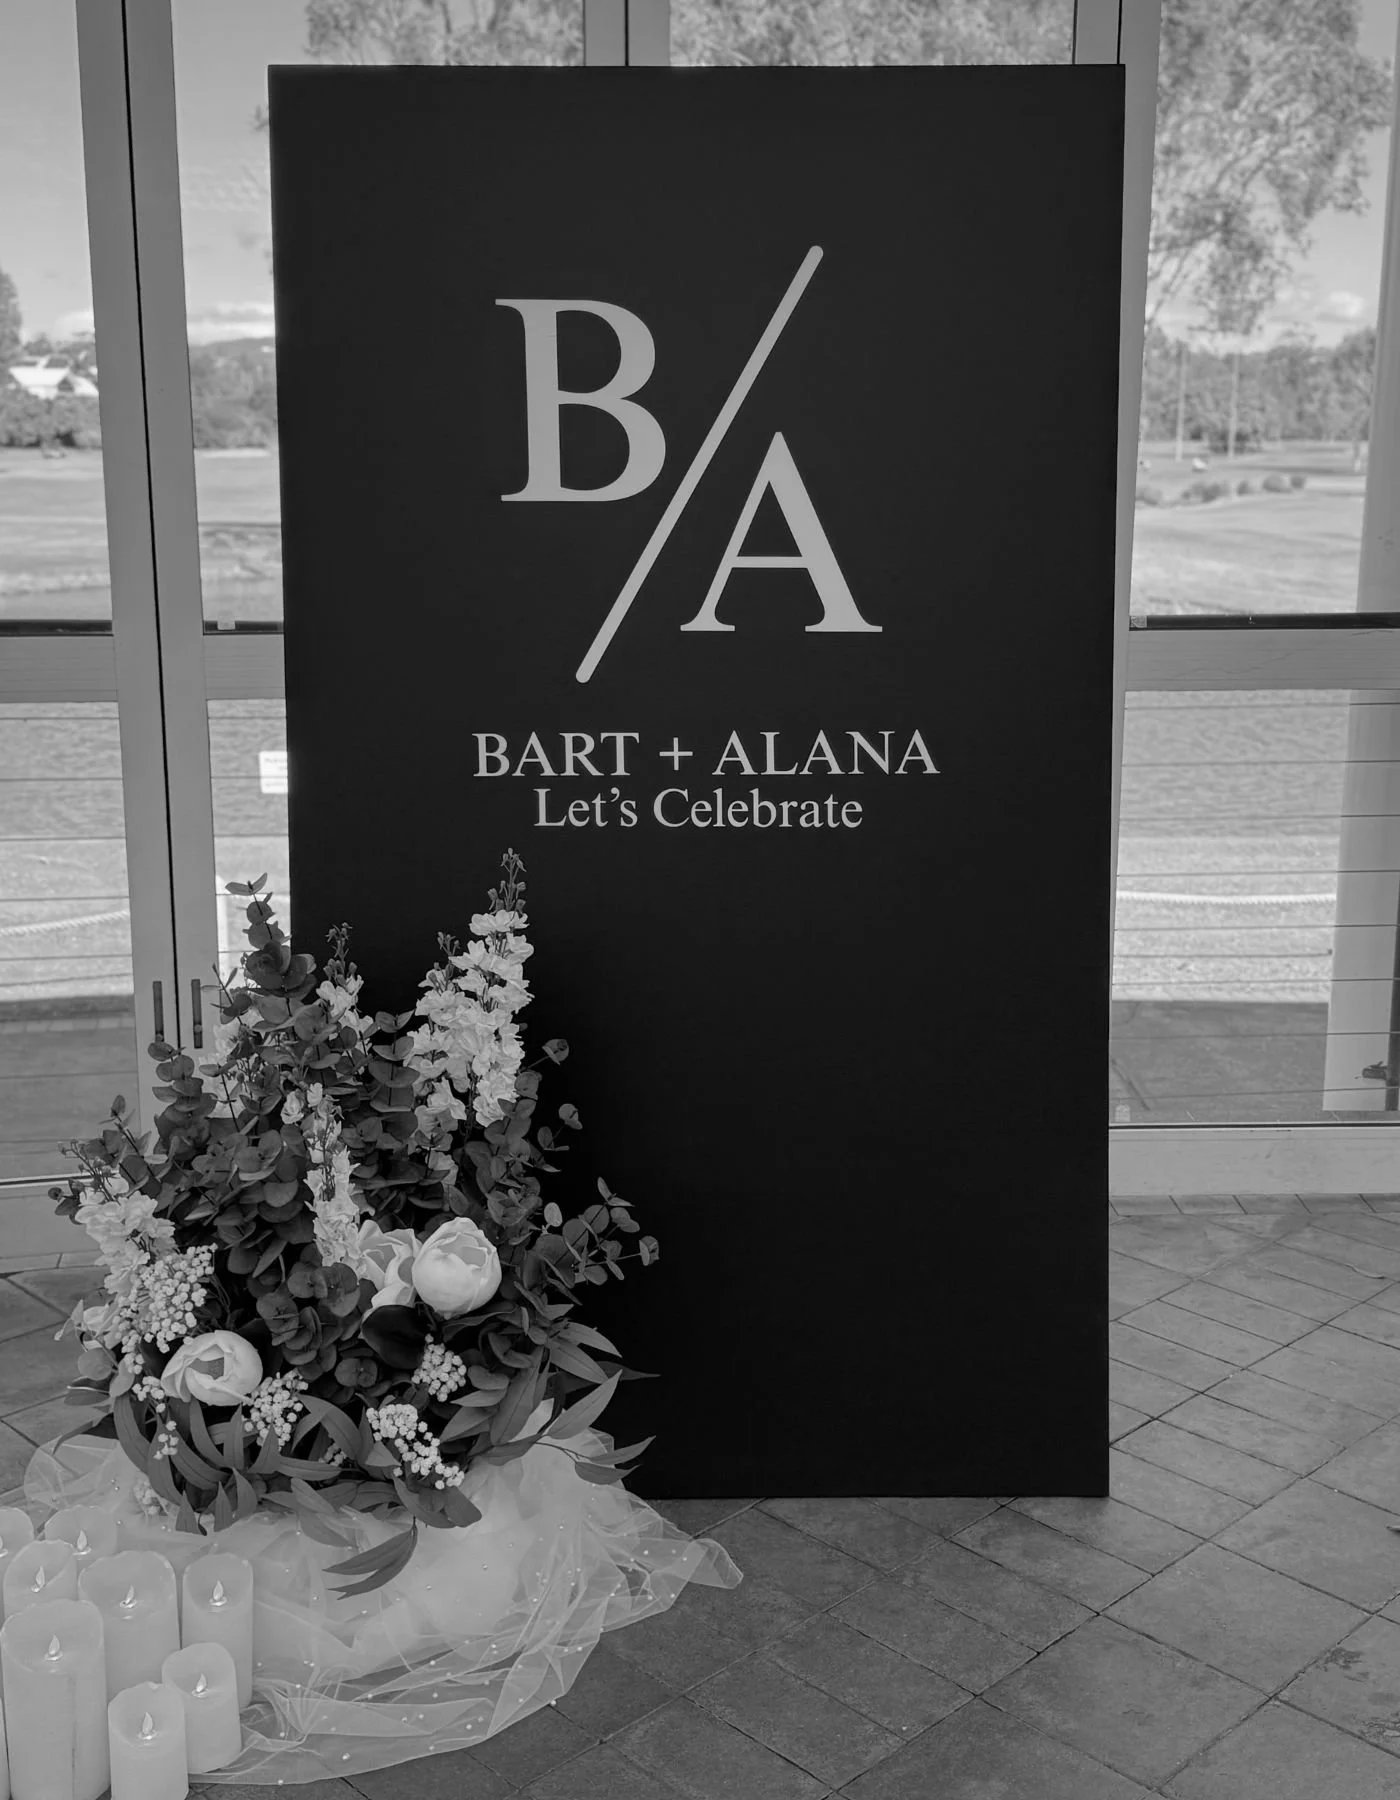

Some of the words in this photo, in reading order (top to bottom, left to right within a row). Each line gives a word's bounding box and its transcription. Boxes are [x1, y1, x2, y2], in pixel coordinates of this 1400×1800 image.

[472, 731, 640, 777] BART
[711, 729, 941, 776] ALANA
[533, 786, 638, 828] Let’s
[653, 787, 863, 828] Celebrate
